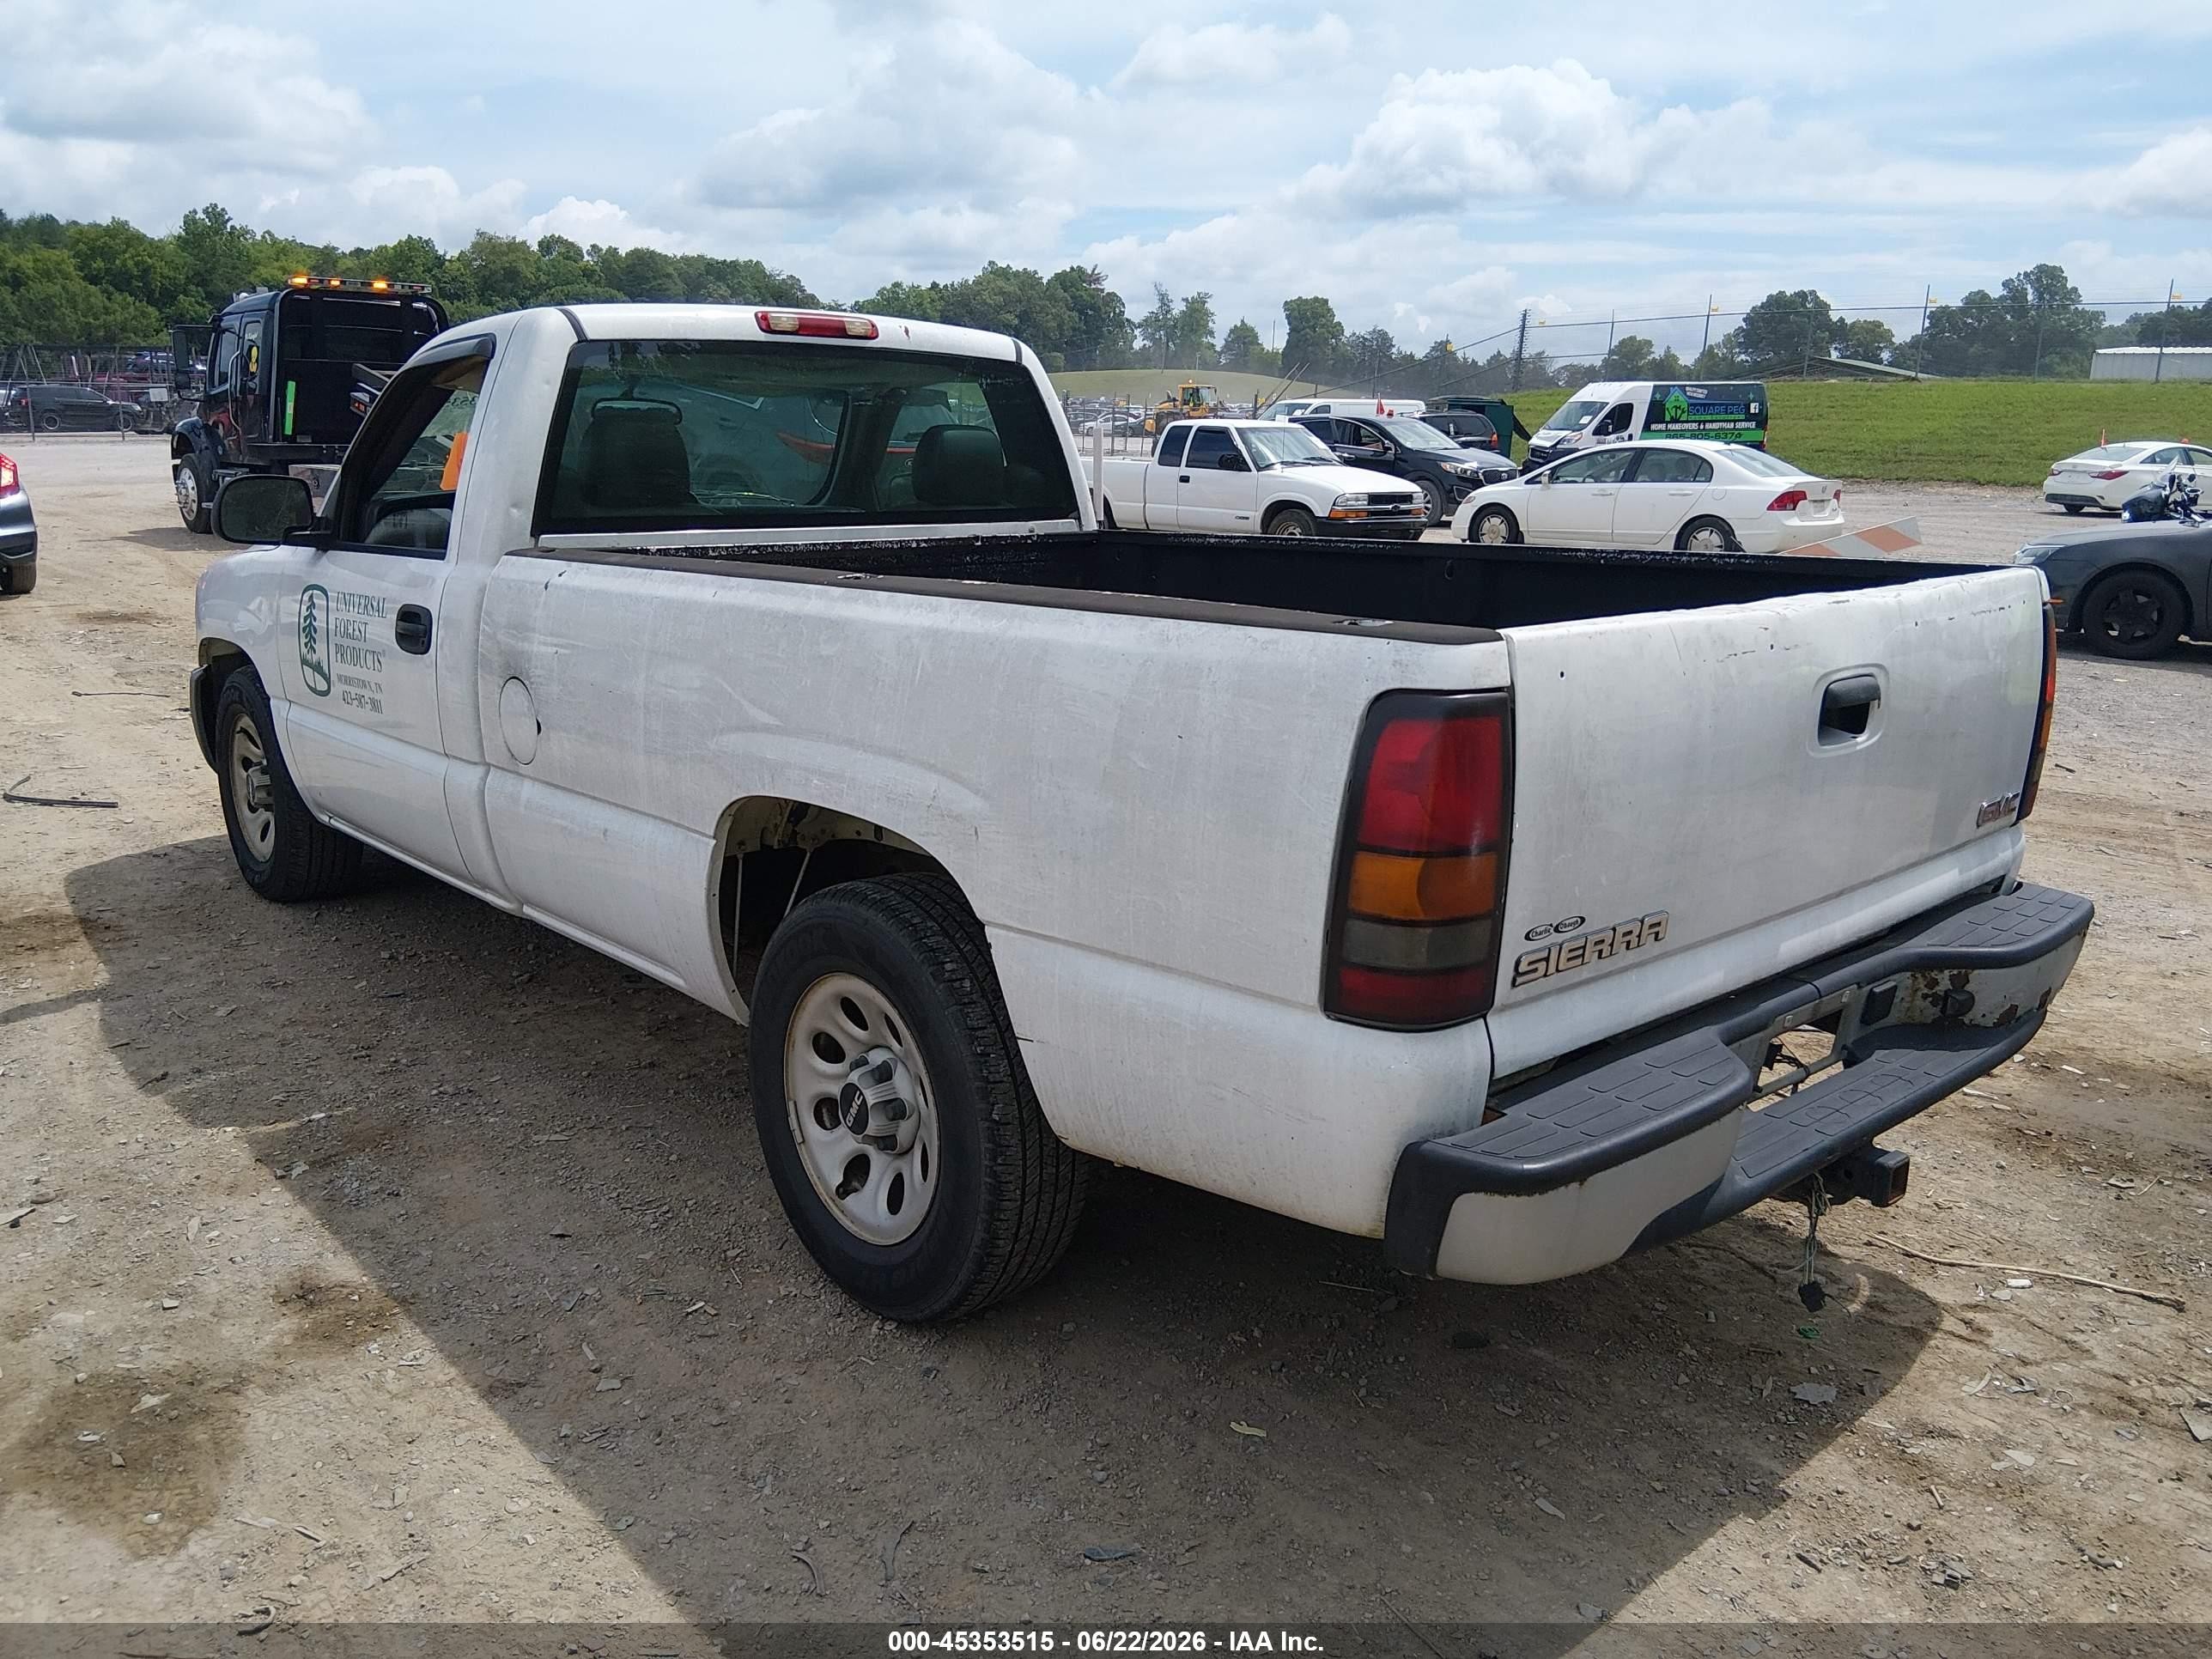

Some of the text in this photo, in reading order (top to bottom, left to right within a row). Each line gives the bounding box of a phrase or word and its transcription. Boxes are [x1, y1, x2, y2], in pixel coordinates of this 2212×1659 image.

[1689, 404, 1746, 415] SQUARE PEG
[336, 591, 386, 619] UNIVERSAL
[334, 617, 368, 643] FOREST
[334, 643, 383, 672] PRODUCTS
[336, 672, 384, 694] MORRISTOWN, TN
[342, 690, 384, 714] 423-587-3811
[1530, 926, 1553, 938] Charlie
[1511, 909, 1670, 989] SIERRA
[846, 1090, 864, 1127] GMC
